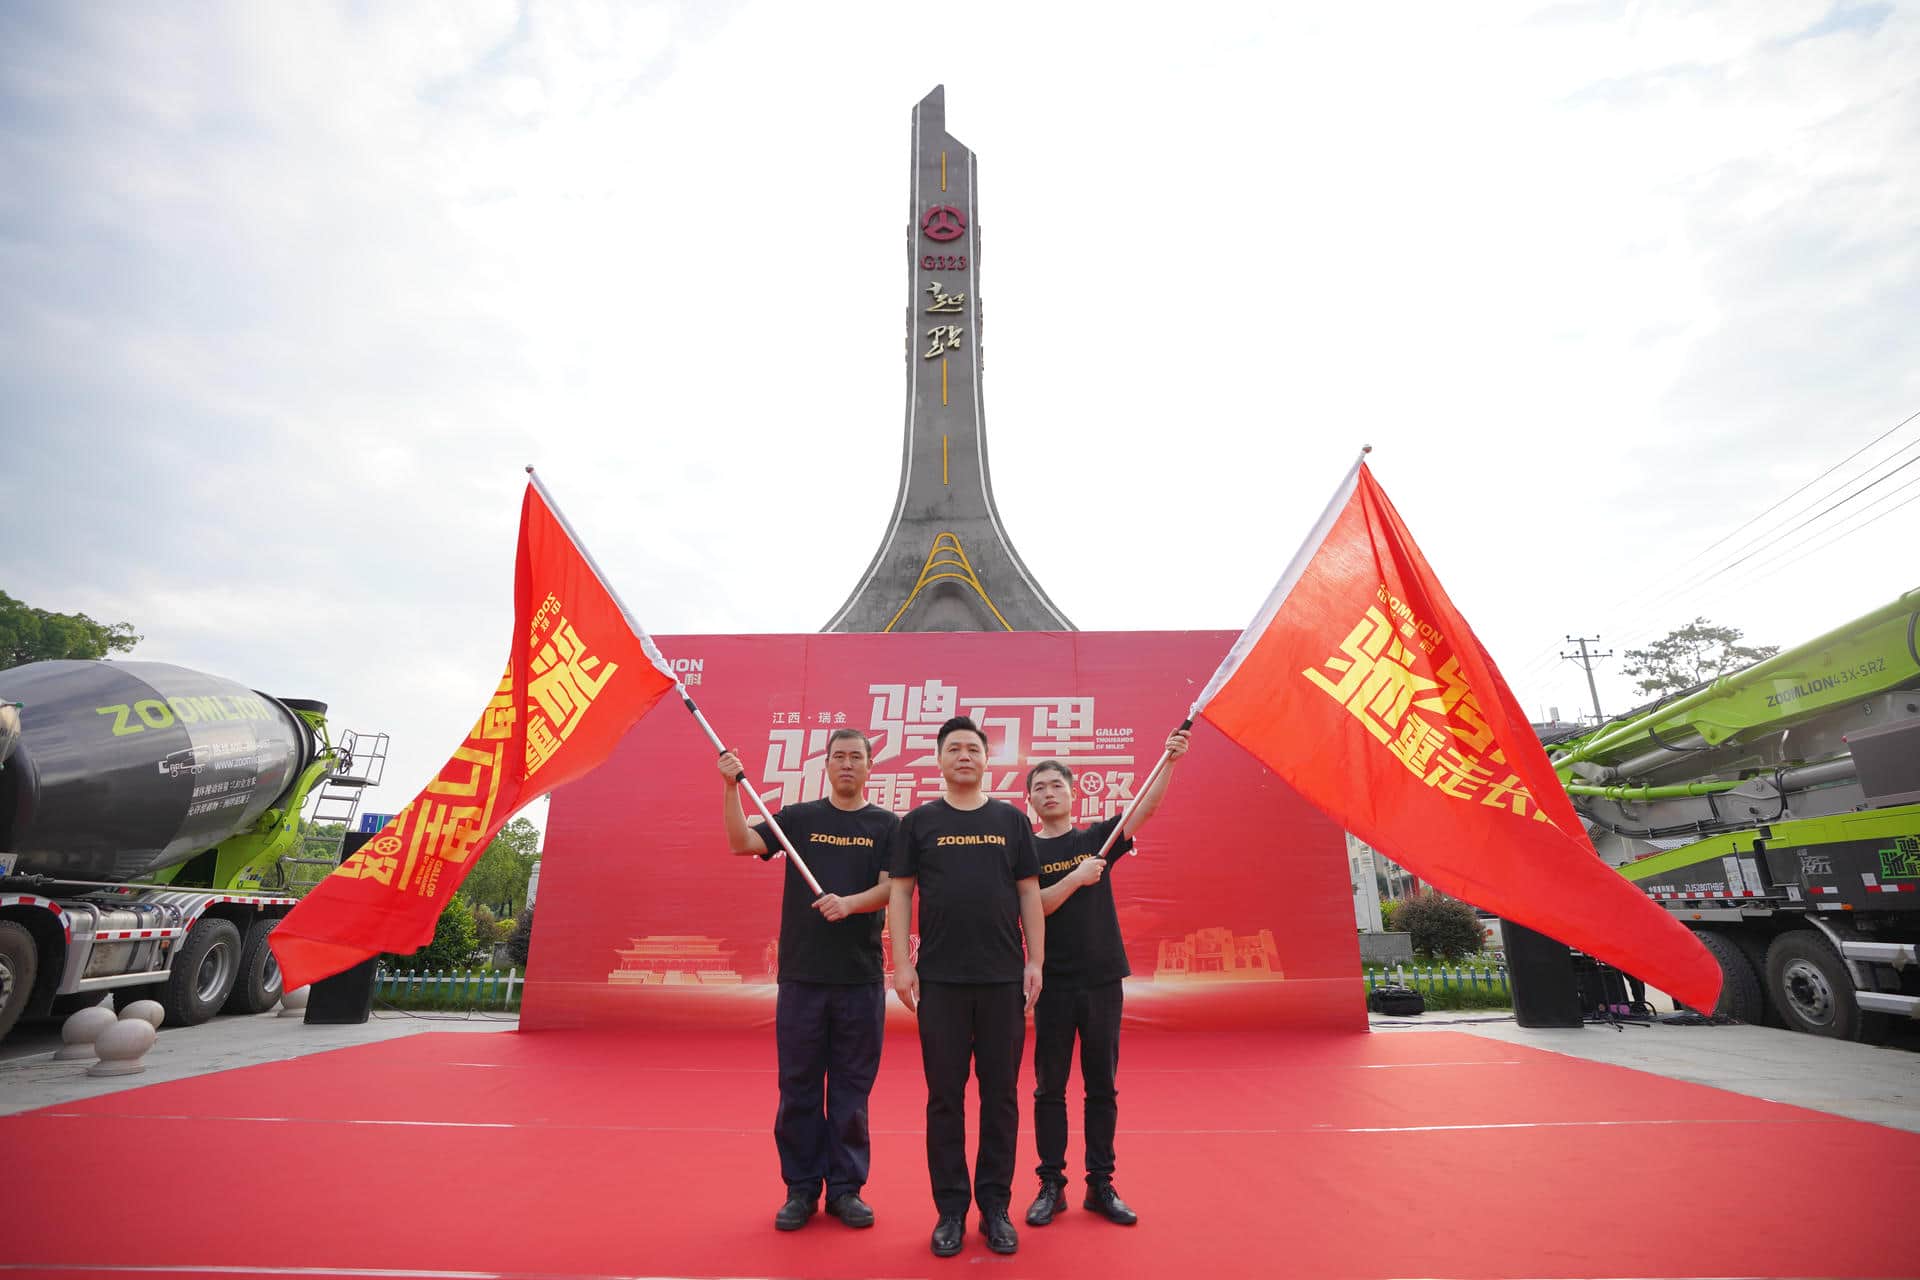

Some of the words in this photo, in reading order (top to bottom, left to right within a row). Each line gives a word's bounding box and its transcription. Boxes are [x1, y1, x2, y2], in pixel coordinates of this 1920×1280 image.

[920, 255, 967, 271] G323
[1379, 584, 1444, 646] OMLION
[1766, 676, 1834, 708] ZOOMLION
[96, 695, 273, 736] ZOOMLION
[1095, 728, 1133, 737] GALLOP
[809, 833, 874, 848] ZOOMLION
[936, 834, 1006, 847] ZOOMLION
[426, 860, 444, 897] GALLOP
